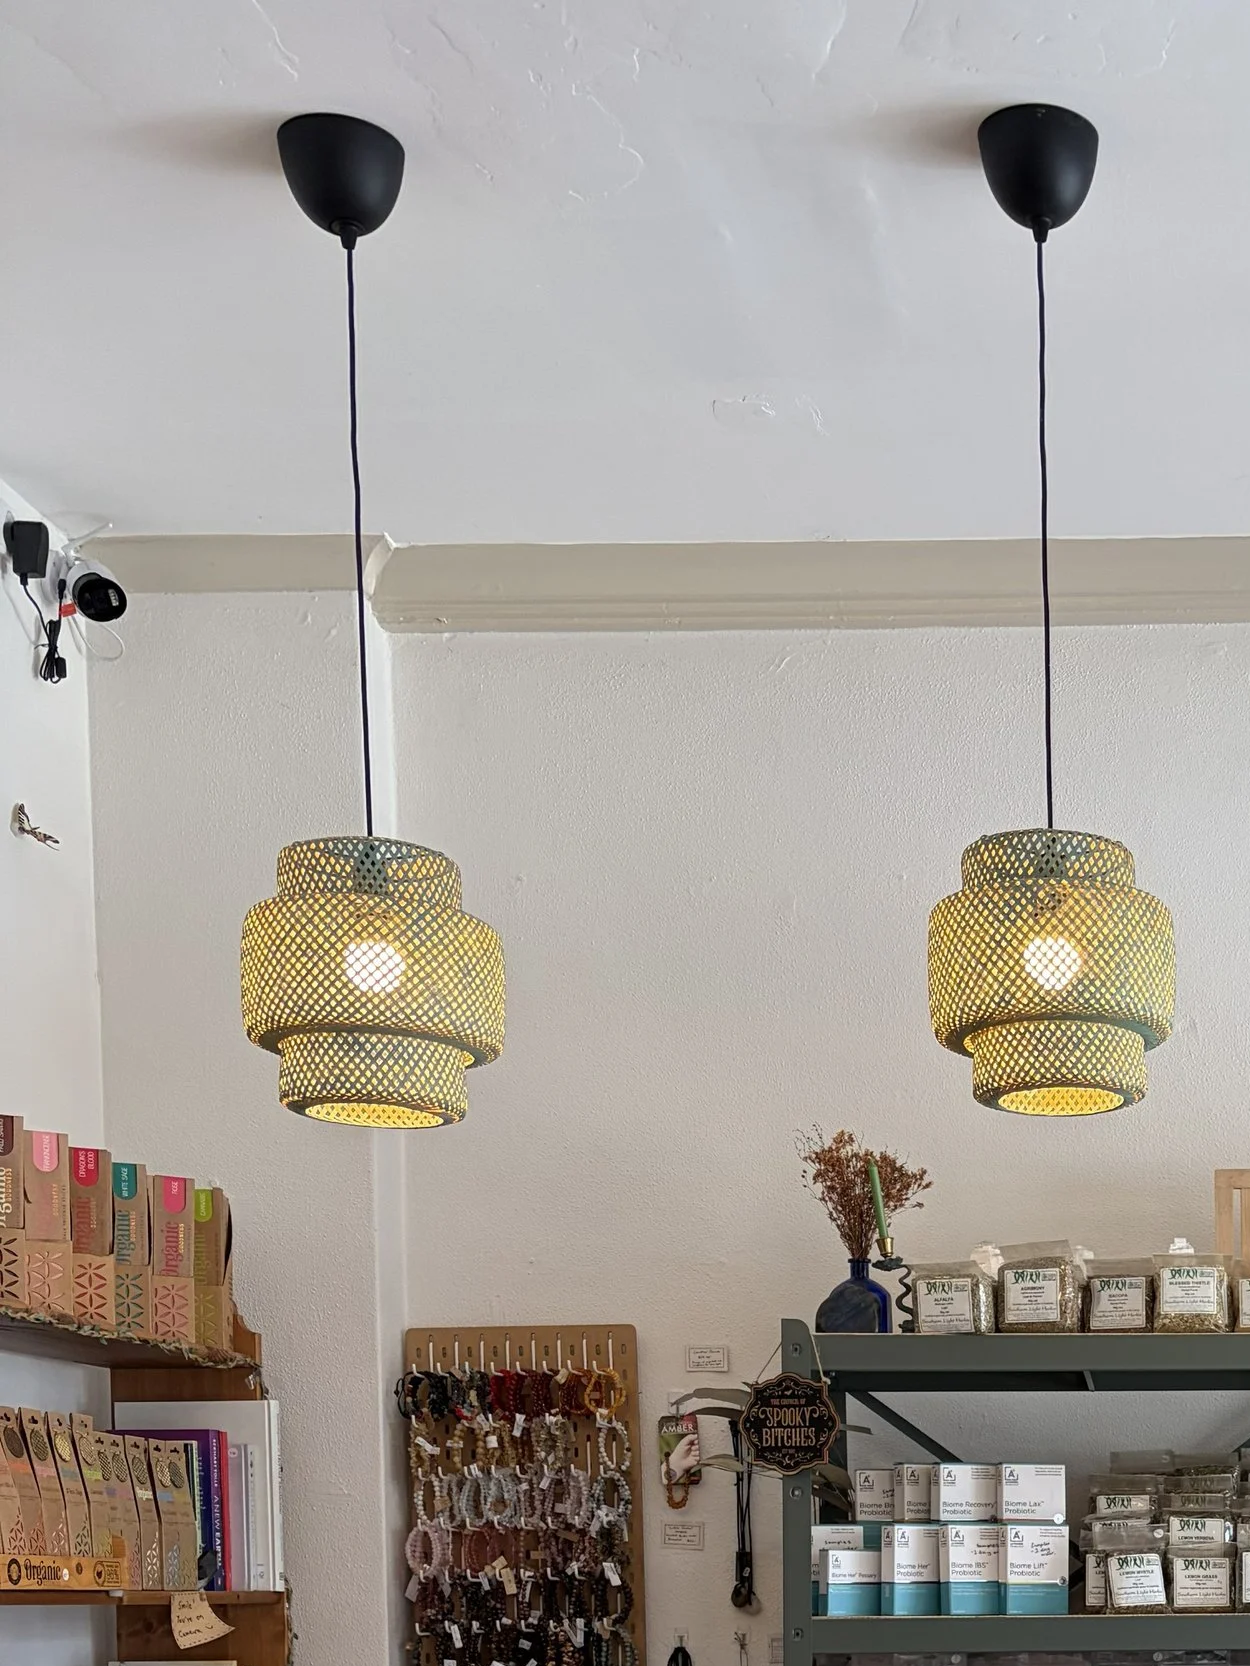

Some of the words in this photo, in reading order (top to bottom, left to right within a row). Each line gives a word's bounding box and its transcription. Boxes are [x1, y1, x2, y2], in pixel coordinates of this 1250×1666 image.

[760, 1408, 819, 1427] SPOOKY
[661, 1424, 694, 1433] AMBER
[761, 1428, 816, 1447] BITCHES
[24, 1559, 61, 1585] Organic
